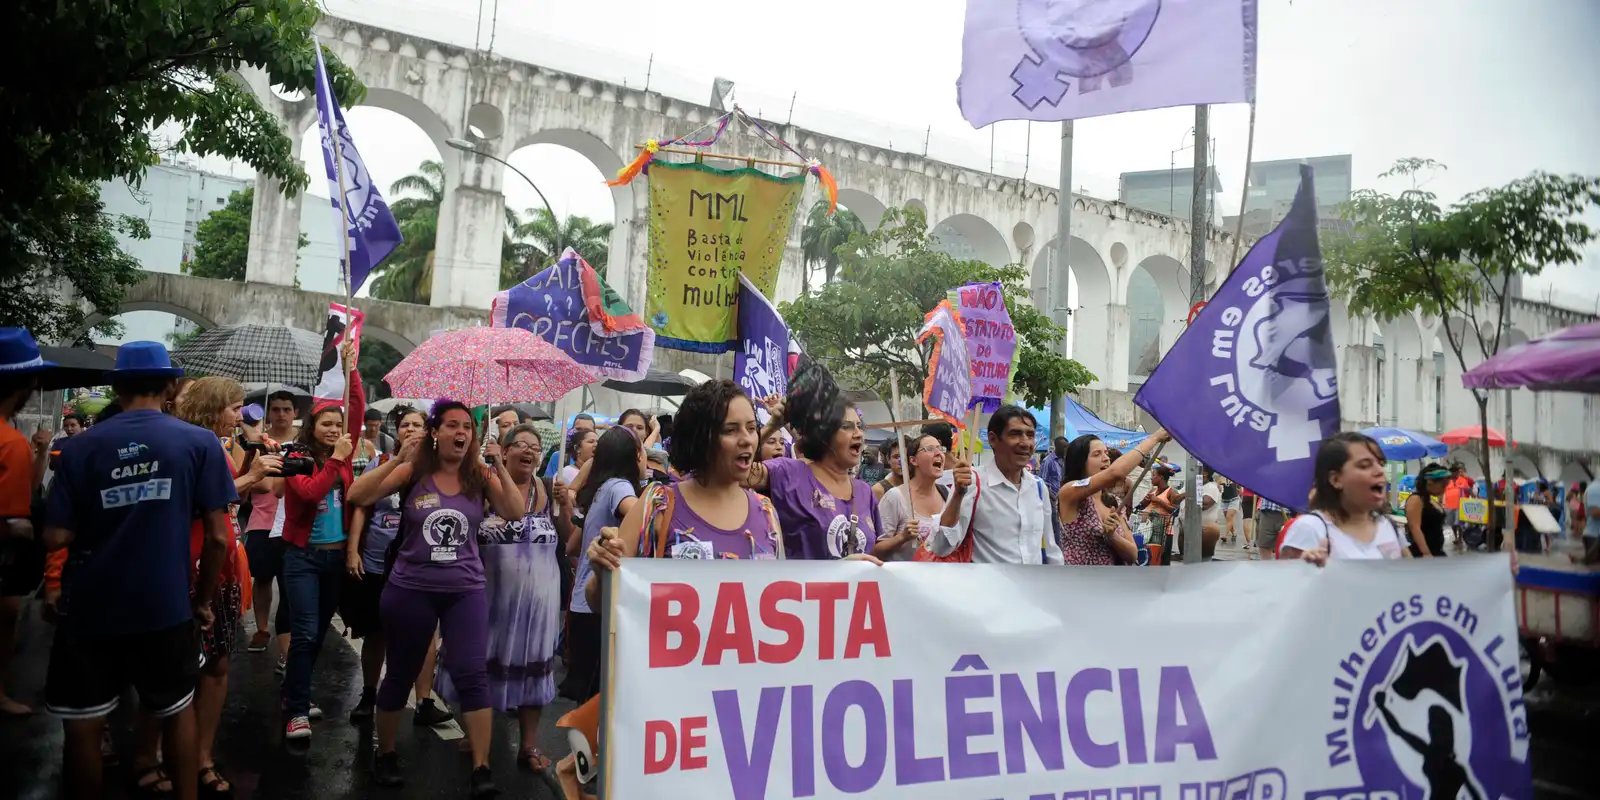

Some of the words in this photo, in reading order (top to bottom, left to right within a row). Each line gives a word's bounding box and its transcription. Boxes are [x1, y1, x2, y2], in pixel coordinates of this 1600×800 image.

[689, 188, 748, 222] MML
[687, 228, 730, 247] Basta
[735, 232, 743, 245] de
[977, 344, 992, 358] DO
[604, 360, 623, 369] MML
[111, 460, 159, 480] CAIXA
[105, 481, 169, 505] STAFF
[649, 580, 892, 668] BASTA
[1326, 594, 1424, 767] Mulheres
[1436, 595, 1478, 635] em
[644, 716, 708, 775] DE
[712, 654, 1218, 800] VIOLÊNCIA
